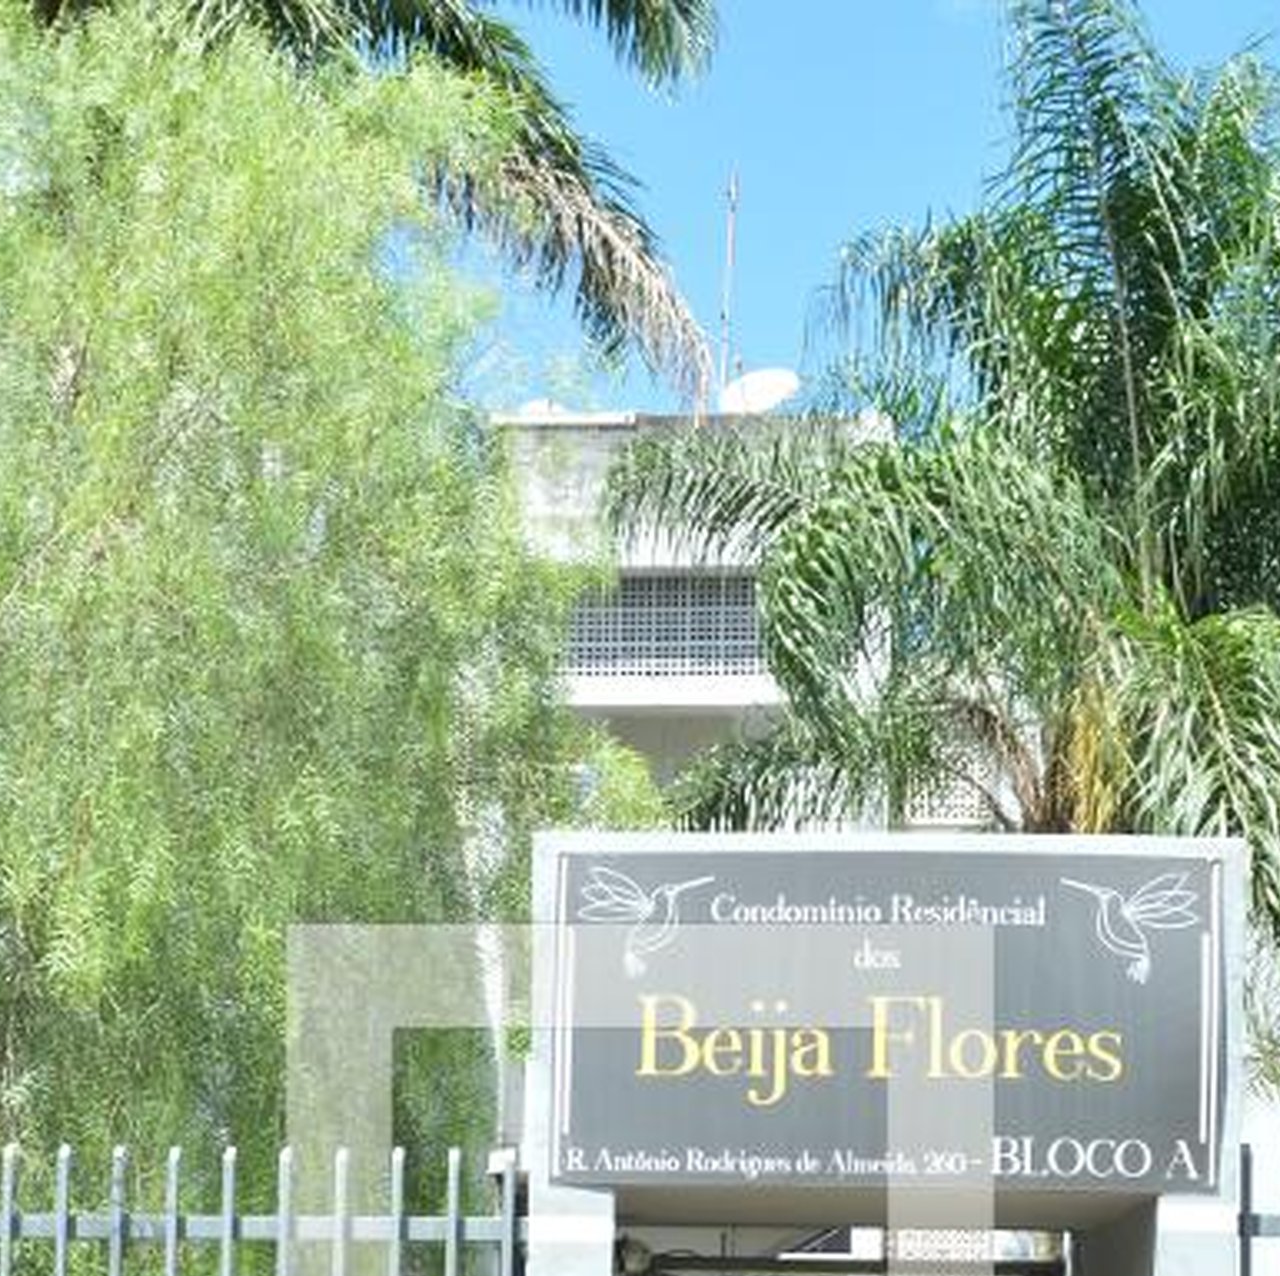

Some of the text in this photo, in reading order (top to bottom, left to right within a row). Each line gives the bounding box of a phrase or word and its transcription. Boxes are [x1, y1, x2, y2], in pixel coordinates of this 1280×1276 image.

[853, 936, 902, 969] dos
[634, 994, 1123, 1106] Beija Flores
[686, 1147, 792, 1181] Rodrigues
[795, 1148, 823, 1174] de
[989, 1135, 1152, 1179] BLOCO
[1166, 1139, 1199, 1180] A
